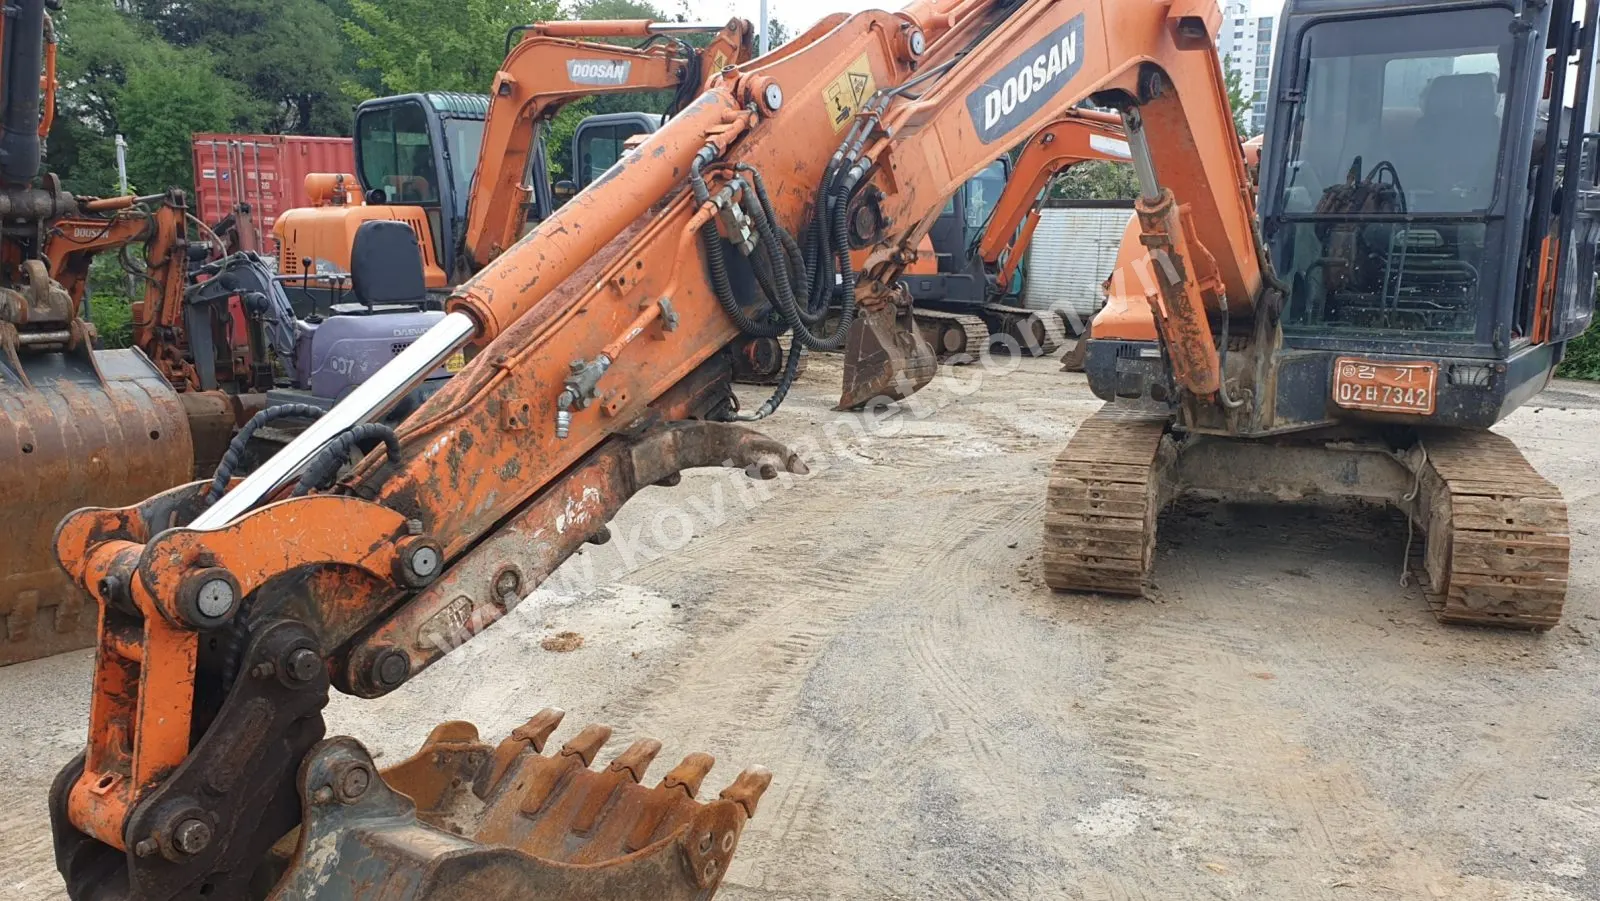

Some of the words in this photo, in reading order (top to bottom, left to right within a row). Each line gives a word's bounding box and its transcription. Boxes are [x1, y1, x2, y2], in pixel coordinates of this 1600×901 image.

[571, 64, 625, 80] DOOSAN
[985, 30, 1076, 131] DOOSAN
[73, 227, 110, 238] DOOSAN
[393, 328, 429, 337] DAEWO
